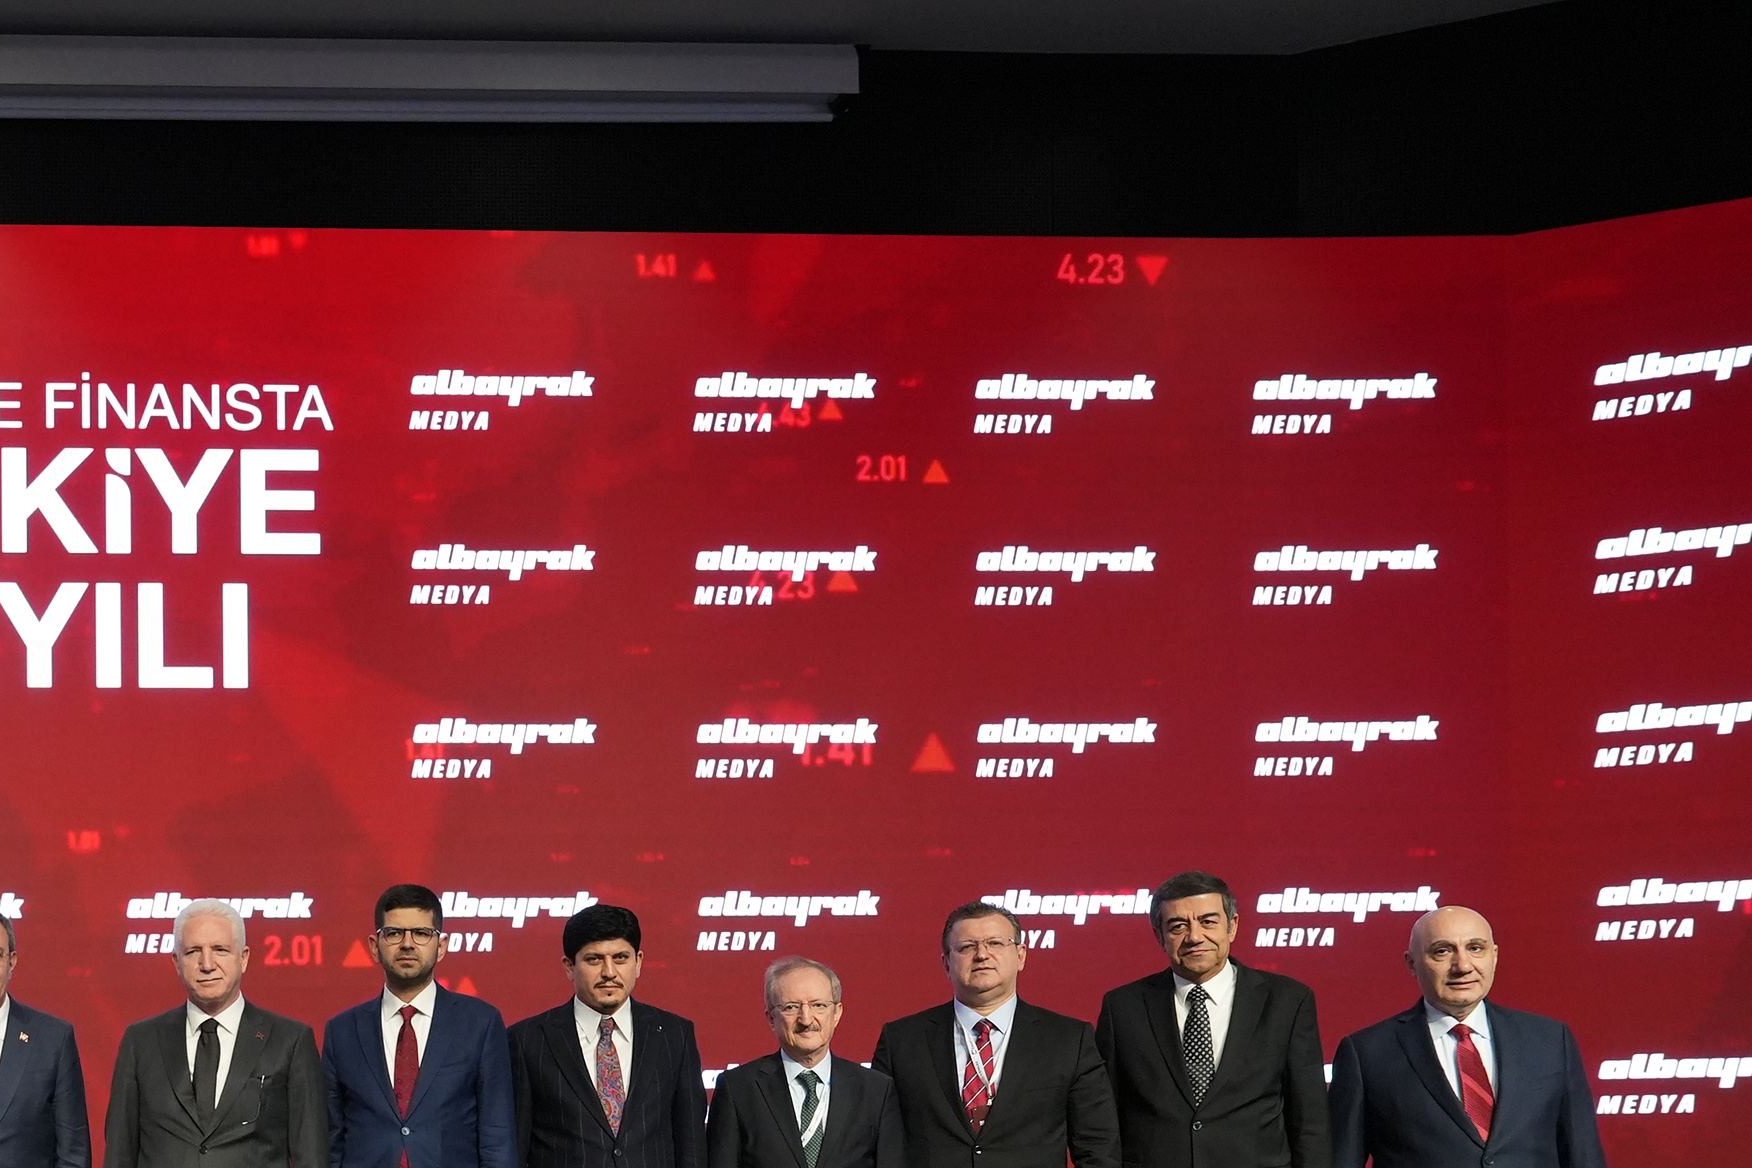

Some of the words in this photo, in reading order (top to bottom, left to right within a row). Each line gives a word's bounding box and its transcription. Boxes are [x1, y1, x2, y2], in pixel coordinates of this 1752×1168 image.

[1057, 252, 1126, 285] 4.23
[46, 371, 333, 431] FİNANSTA
[411, 370, 594, 406] albayrak
[695, 372, 876, 408] albayrak
[975, 374, 1155, 410] albayrak
[1253, 373, 1437, 409] albayrak
[1593, 390, 1691, 421] MEDYA
[409, 411, 488, 430] MEDYA
[693, 413, 771, 432] MEDYA
[974, 415, 1051, 433] MEDYA
[1252, 415, 1331, 434] MEDYA
[856, 454, 908, 482] 2.01
[412, 544, 595, 580] albayrak
[696, 545, 877, 581] albayrak
[976, 546, 1156, 582] albayrak
[1254, 544, 1438, 580] albayrak
[410, 585, 489, 604] MEDYA
[1594, 566, 1692, 595] MEDYA
[694, 586, 772, 605] MEDYA
[975, 587, 1052, 605] MEDYA
[1253, 586, 1332, 605] MEDYA
[413, 718, 597, 754] albayrak
[697, 718, 878, 754] albayrak
[977, 718, 1157, 753] albayrak
[1255, 715, 1439, 751] albayrak
[412, 759, 491, 778] MEDYA
[696, 759, 773, 778] MEDYA
[976, 759, 1053, 777] MEDYA
[1254, 757, 1333, 776] MEDYA
[1594, 742, 1693, 767] MEDYA
[125, 892, 313, 918] albrak
[438, 892, 598, 928] lbayrak
[698, 890, 880, 926] albayrak
[1257, 886, 1440, 922] albayrak
[697, 932, 775, 950] MEDYA
[1256, 928, 1334, 947] MEDYA
[1595, 918, 1694, 941] MEDYA
[263, 934, 324, 966] 2.01
[1596, 1094, 1695, 1114] MEDYA
